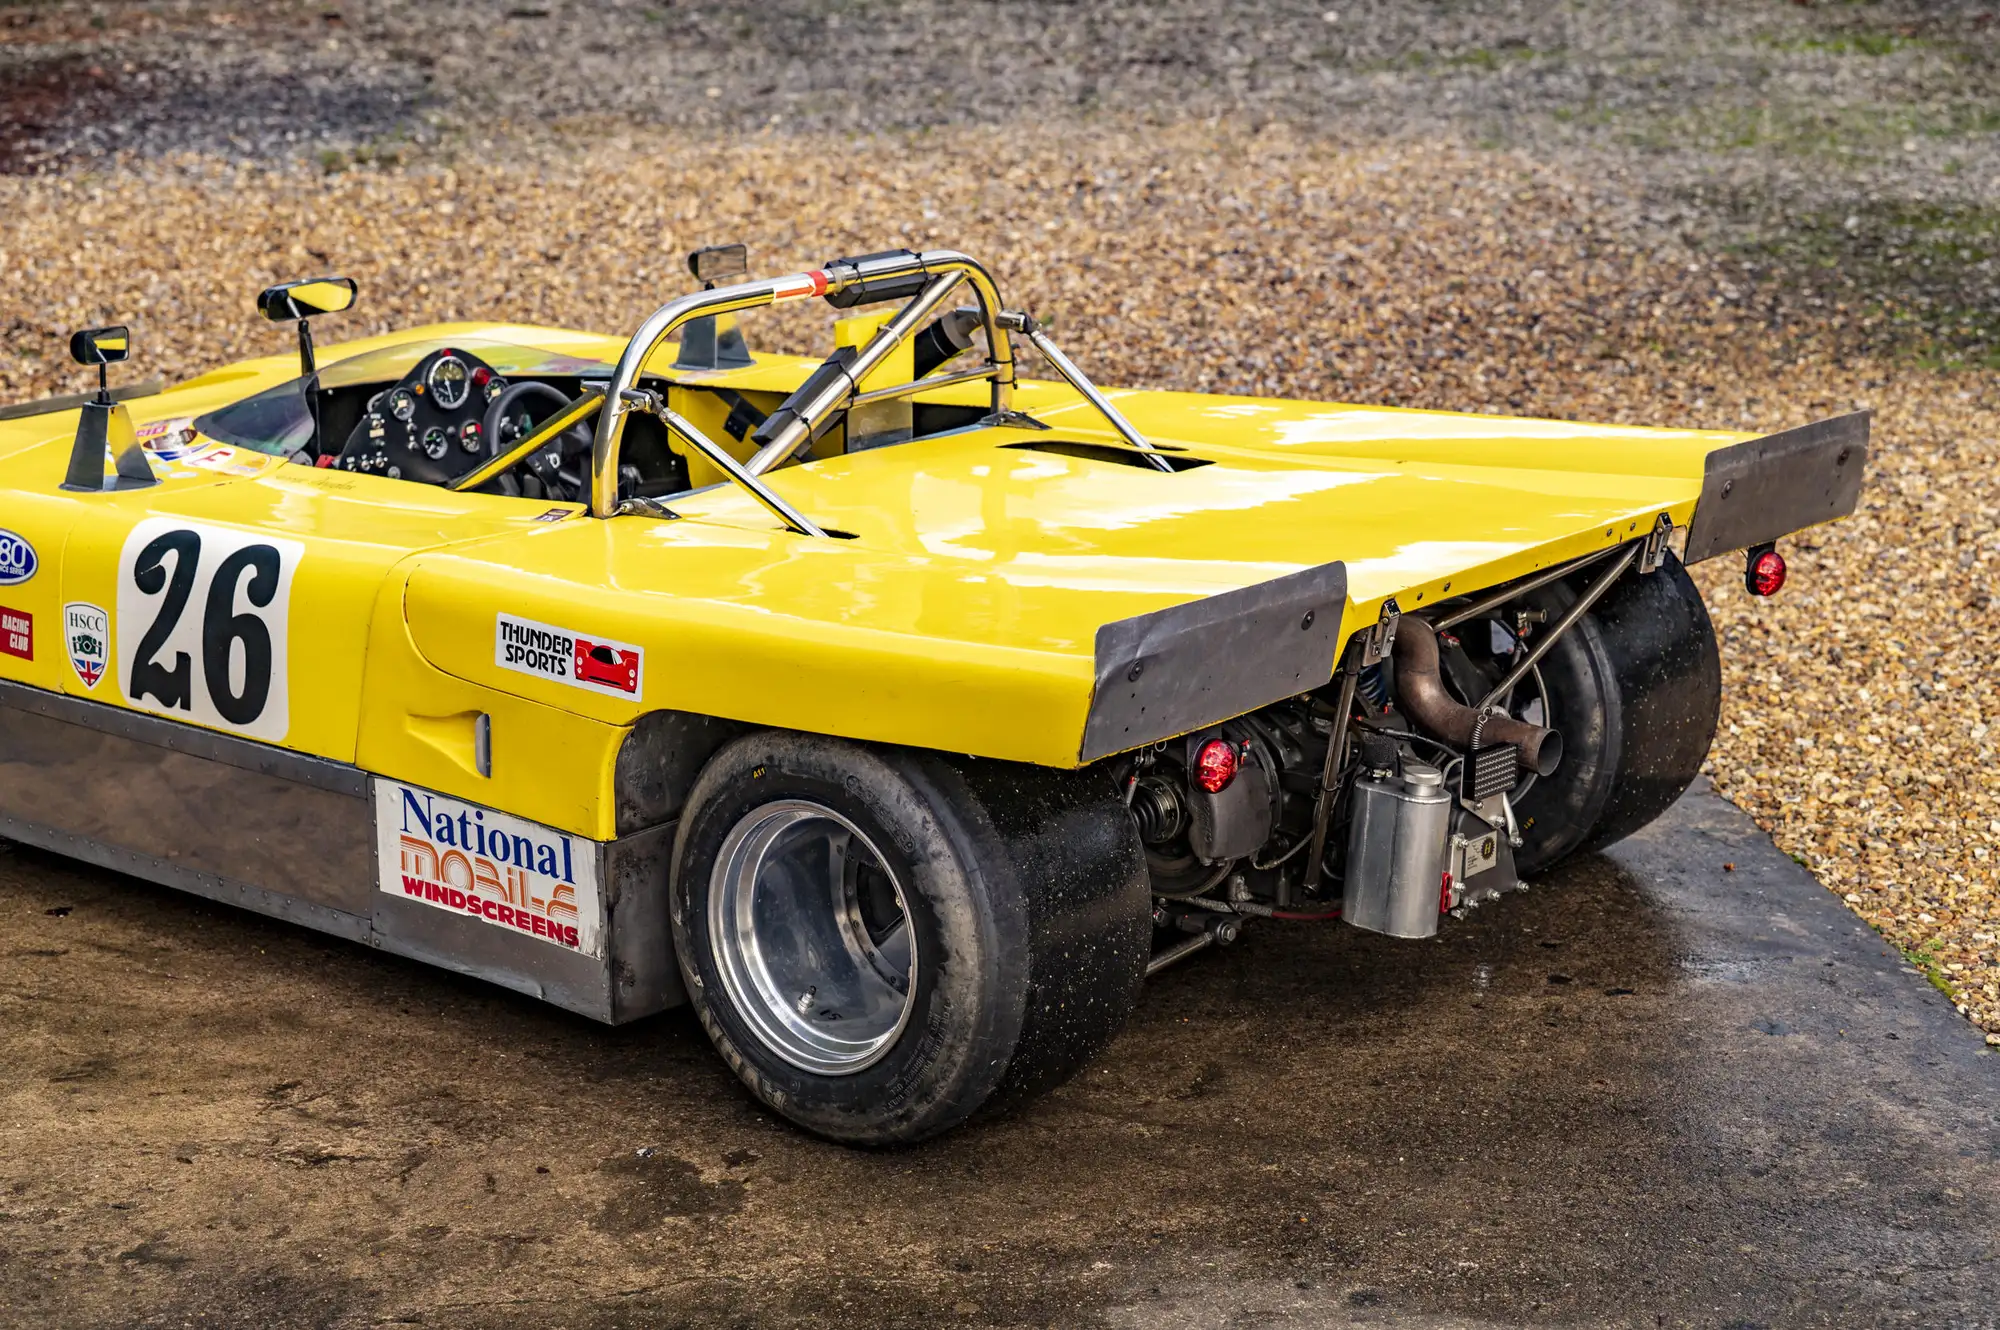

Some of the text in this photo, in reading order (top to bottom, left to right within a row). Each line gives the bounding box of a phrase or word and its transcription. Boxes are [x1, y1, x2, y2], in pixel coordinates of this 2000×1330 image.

[2, 614, 30, 635] RACING
[69, 612, 104, 632] HSCC
[130, 529, 281, 725] 26
[500, 621, 573, 657] THUNDER
[9, 633, 29, 652] CLUB
[505, 644, 567, 676] SPORTS
[398, 787, 576, 884] National
[401, 875, 580, 947] WINDSCREENS
